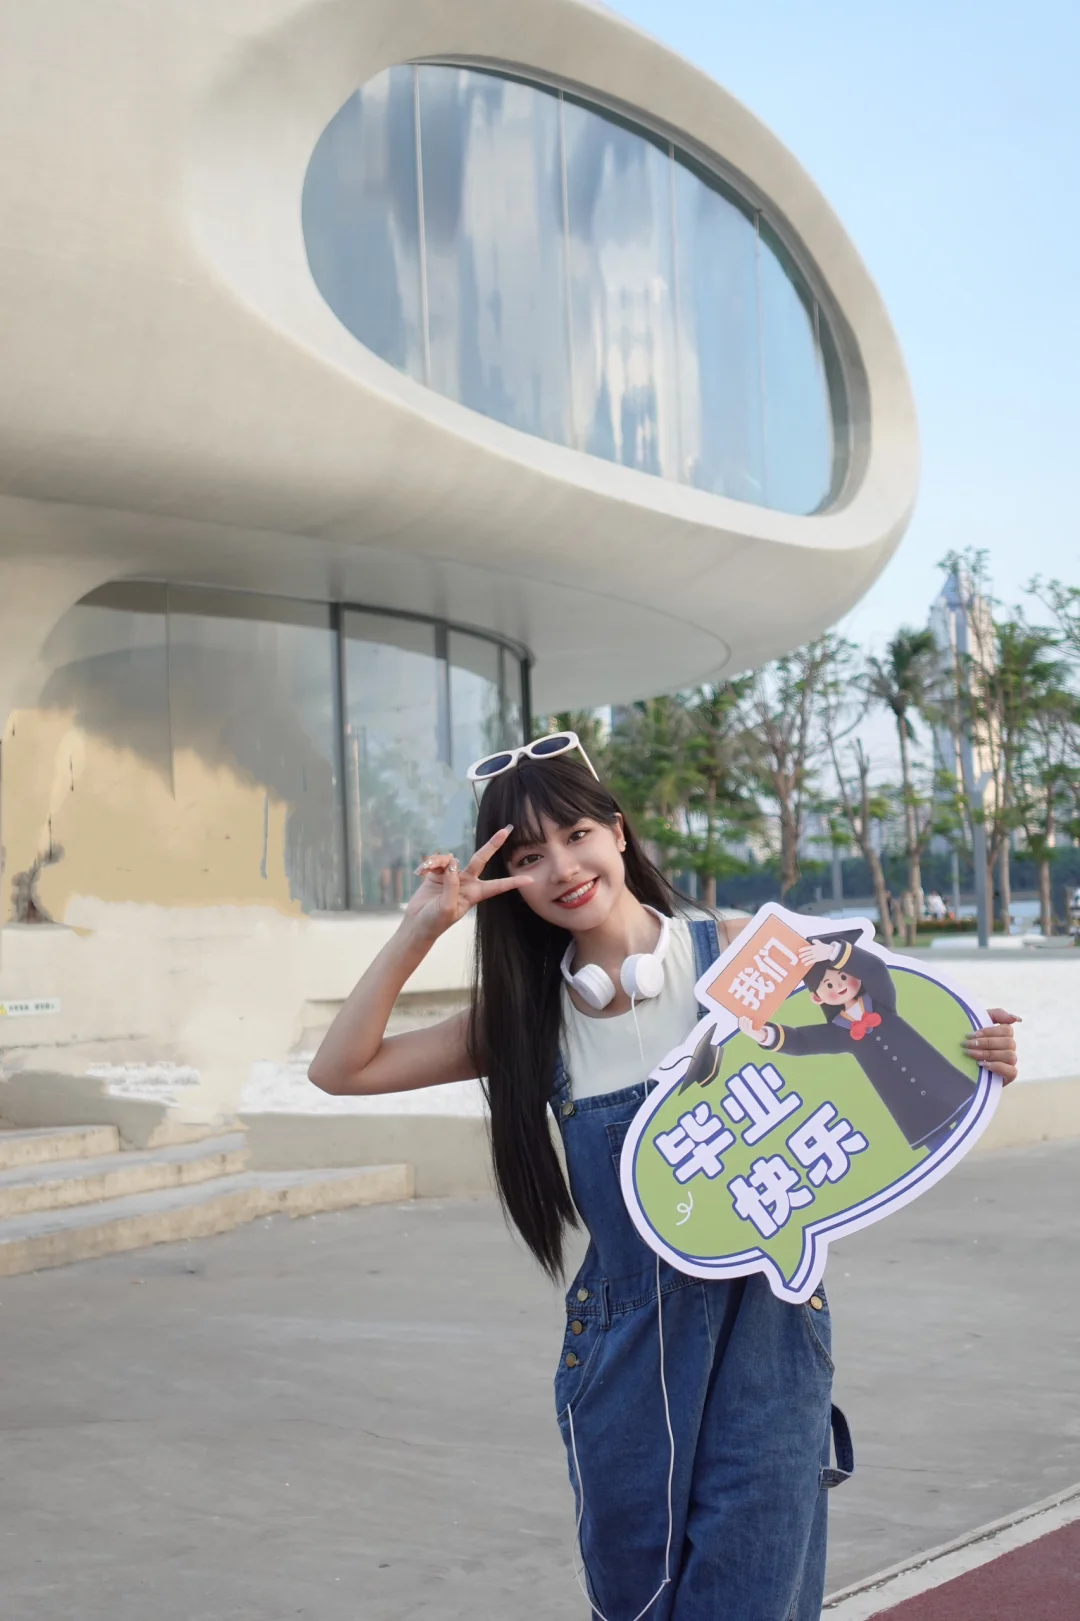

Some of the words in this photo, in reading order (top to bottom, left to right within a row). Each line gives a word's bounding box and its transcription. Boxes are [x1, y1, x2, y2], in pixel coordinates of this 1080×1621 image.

[728, 937, 798, 1010] 我们
[653, 1062, 802, 1184] 毕业
[727, 1102, 869, 1239] 快乐
